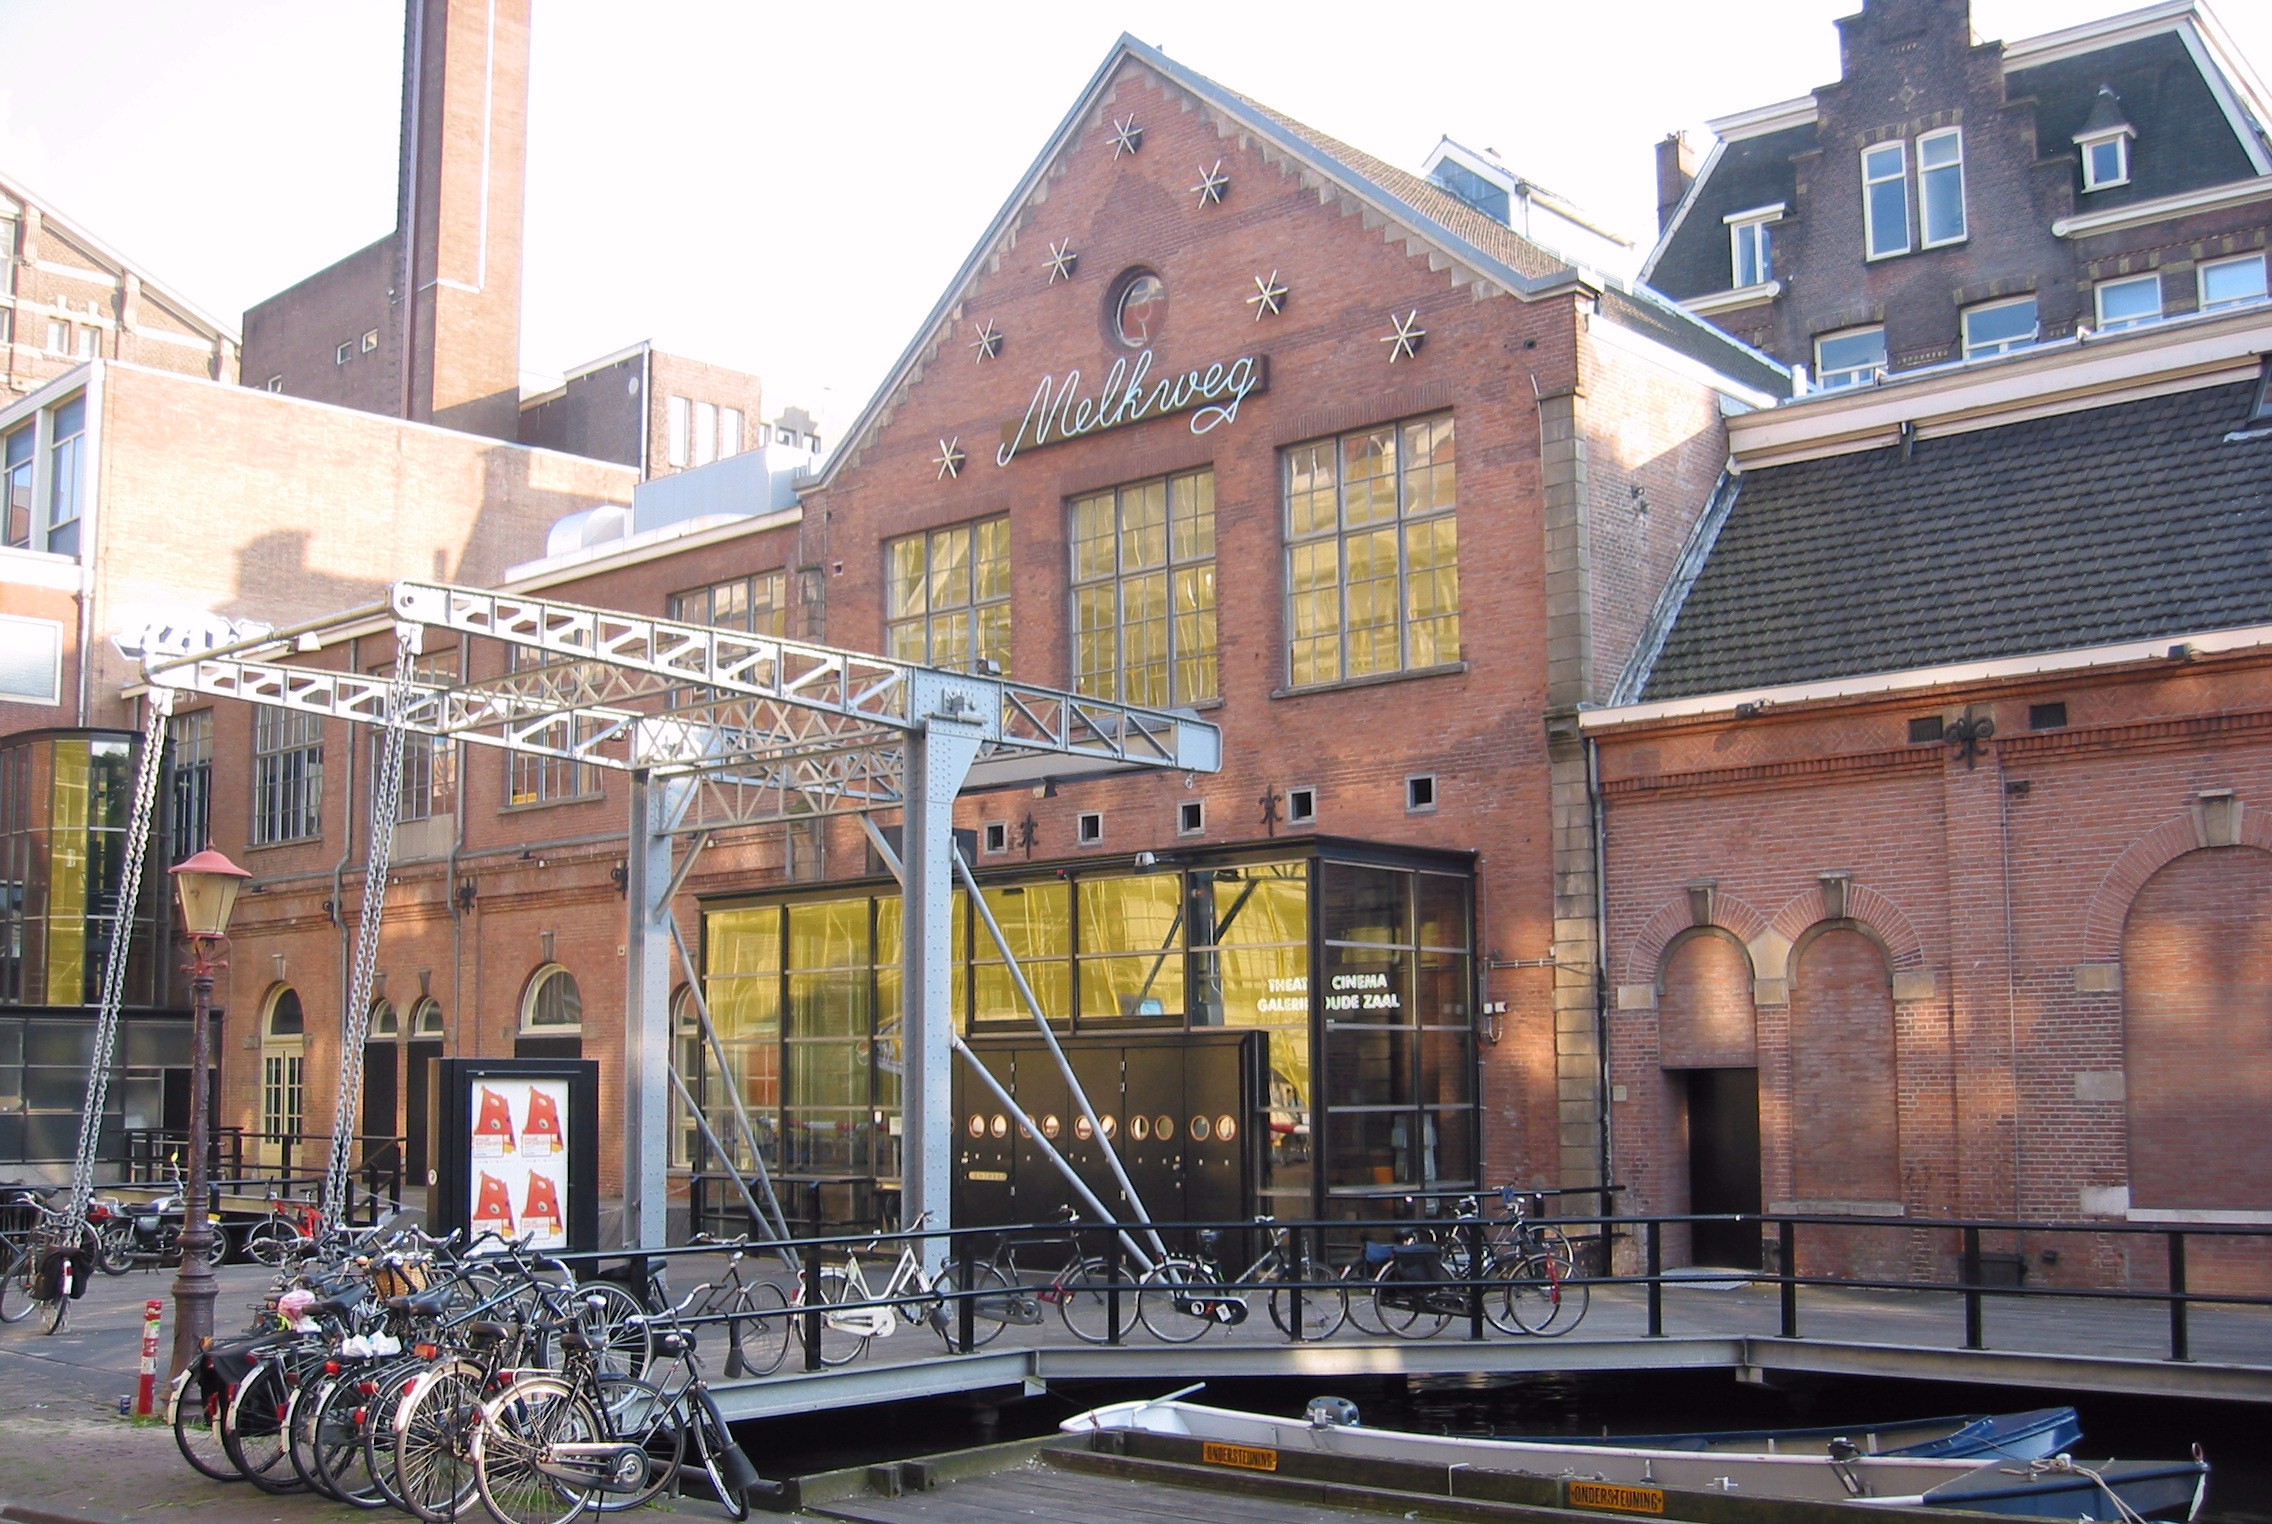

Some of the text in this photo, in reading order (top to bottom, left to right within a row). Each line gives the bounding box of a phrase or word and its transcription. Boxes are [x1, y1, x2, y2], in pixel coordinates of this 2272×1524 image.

[996, 350, 1257, 467] Melkweg
[1268, 973, 1388, 992] THEAT CINEMA
[1362, 993, 1400, 1009] ZAAL
[1575, 1485, 1659, 1510] ONDERSTEUNING
